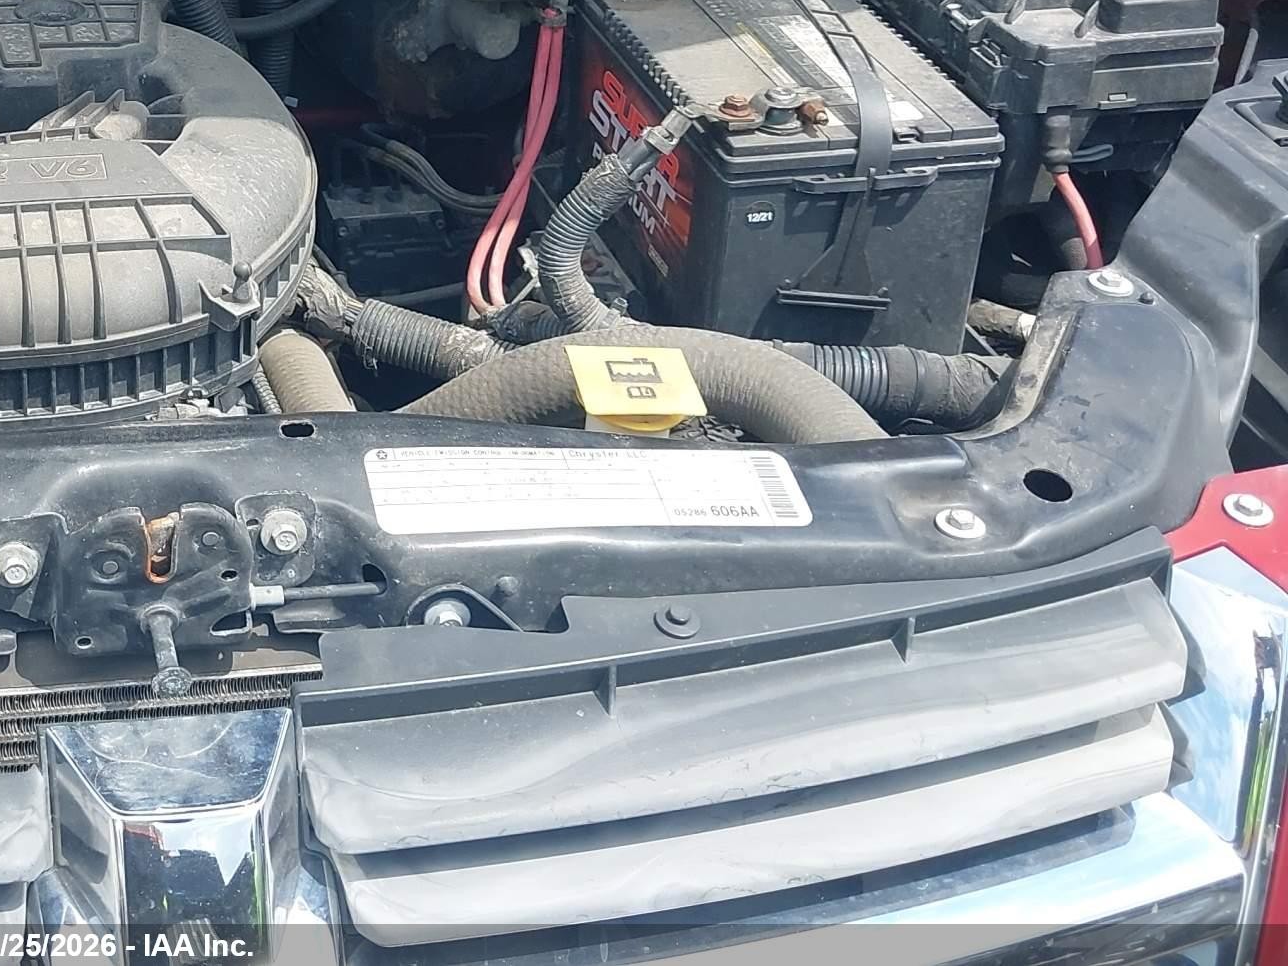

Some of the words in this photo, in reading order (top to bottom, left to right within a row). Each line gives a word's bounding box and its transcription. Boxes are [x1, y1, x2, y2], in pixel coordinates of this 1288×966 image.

[602, 70, 680, 186] SUPR
[589, 89, 678, 212] STRT
[28, 157, 99, 180] V6
[746, 211, 774, 223] 12/21
[710, 505, 761, 518] 606AA
